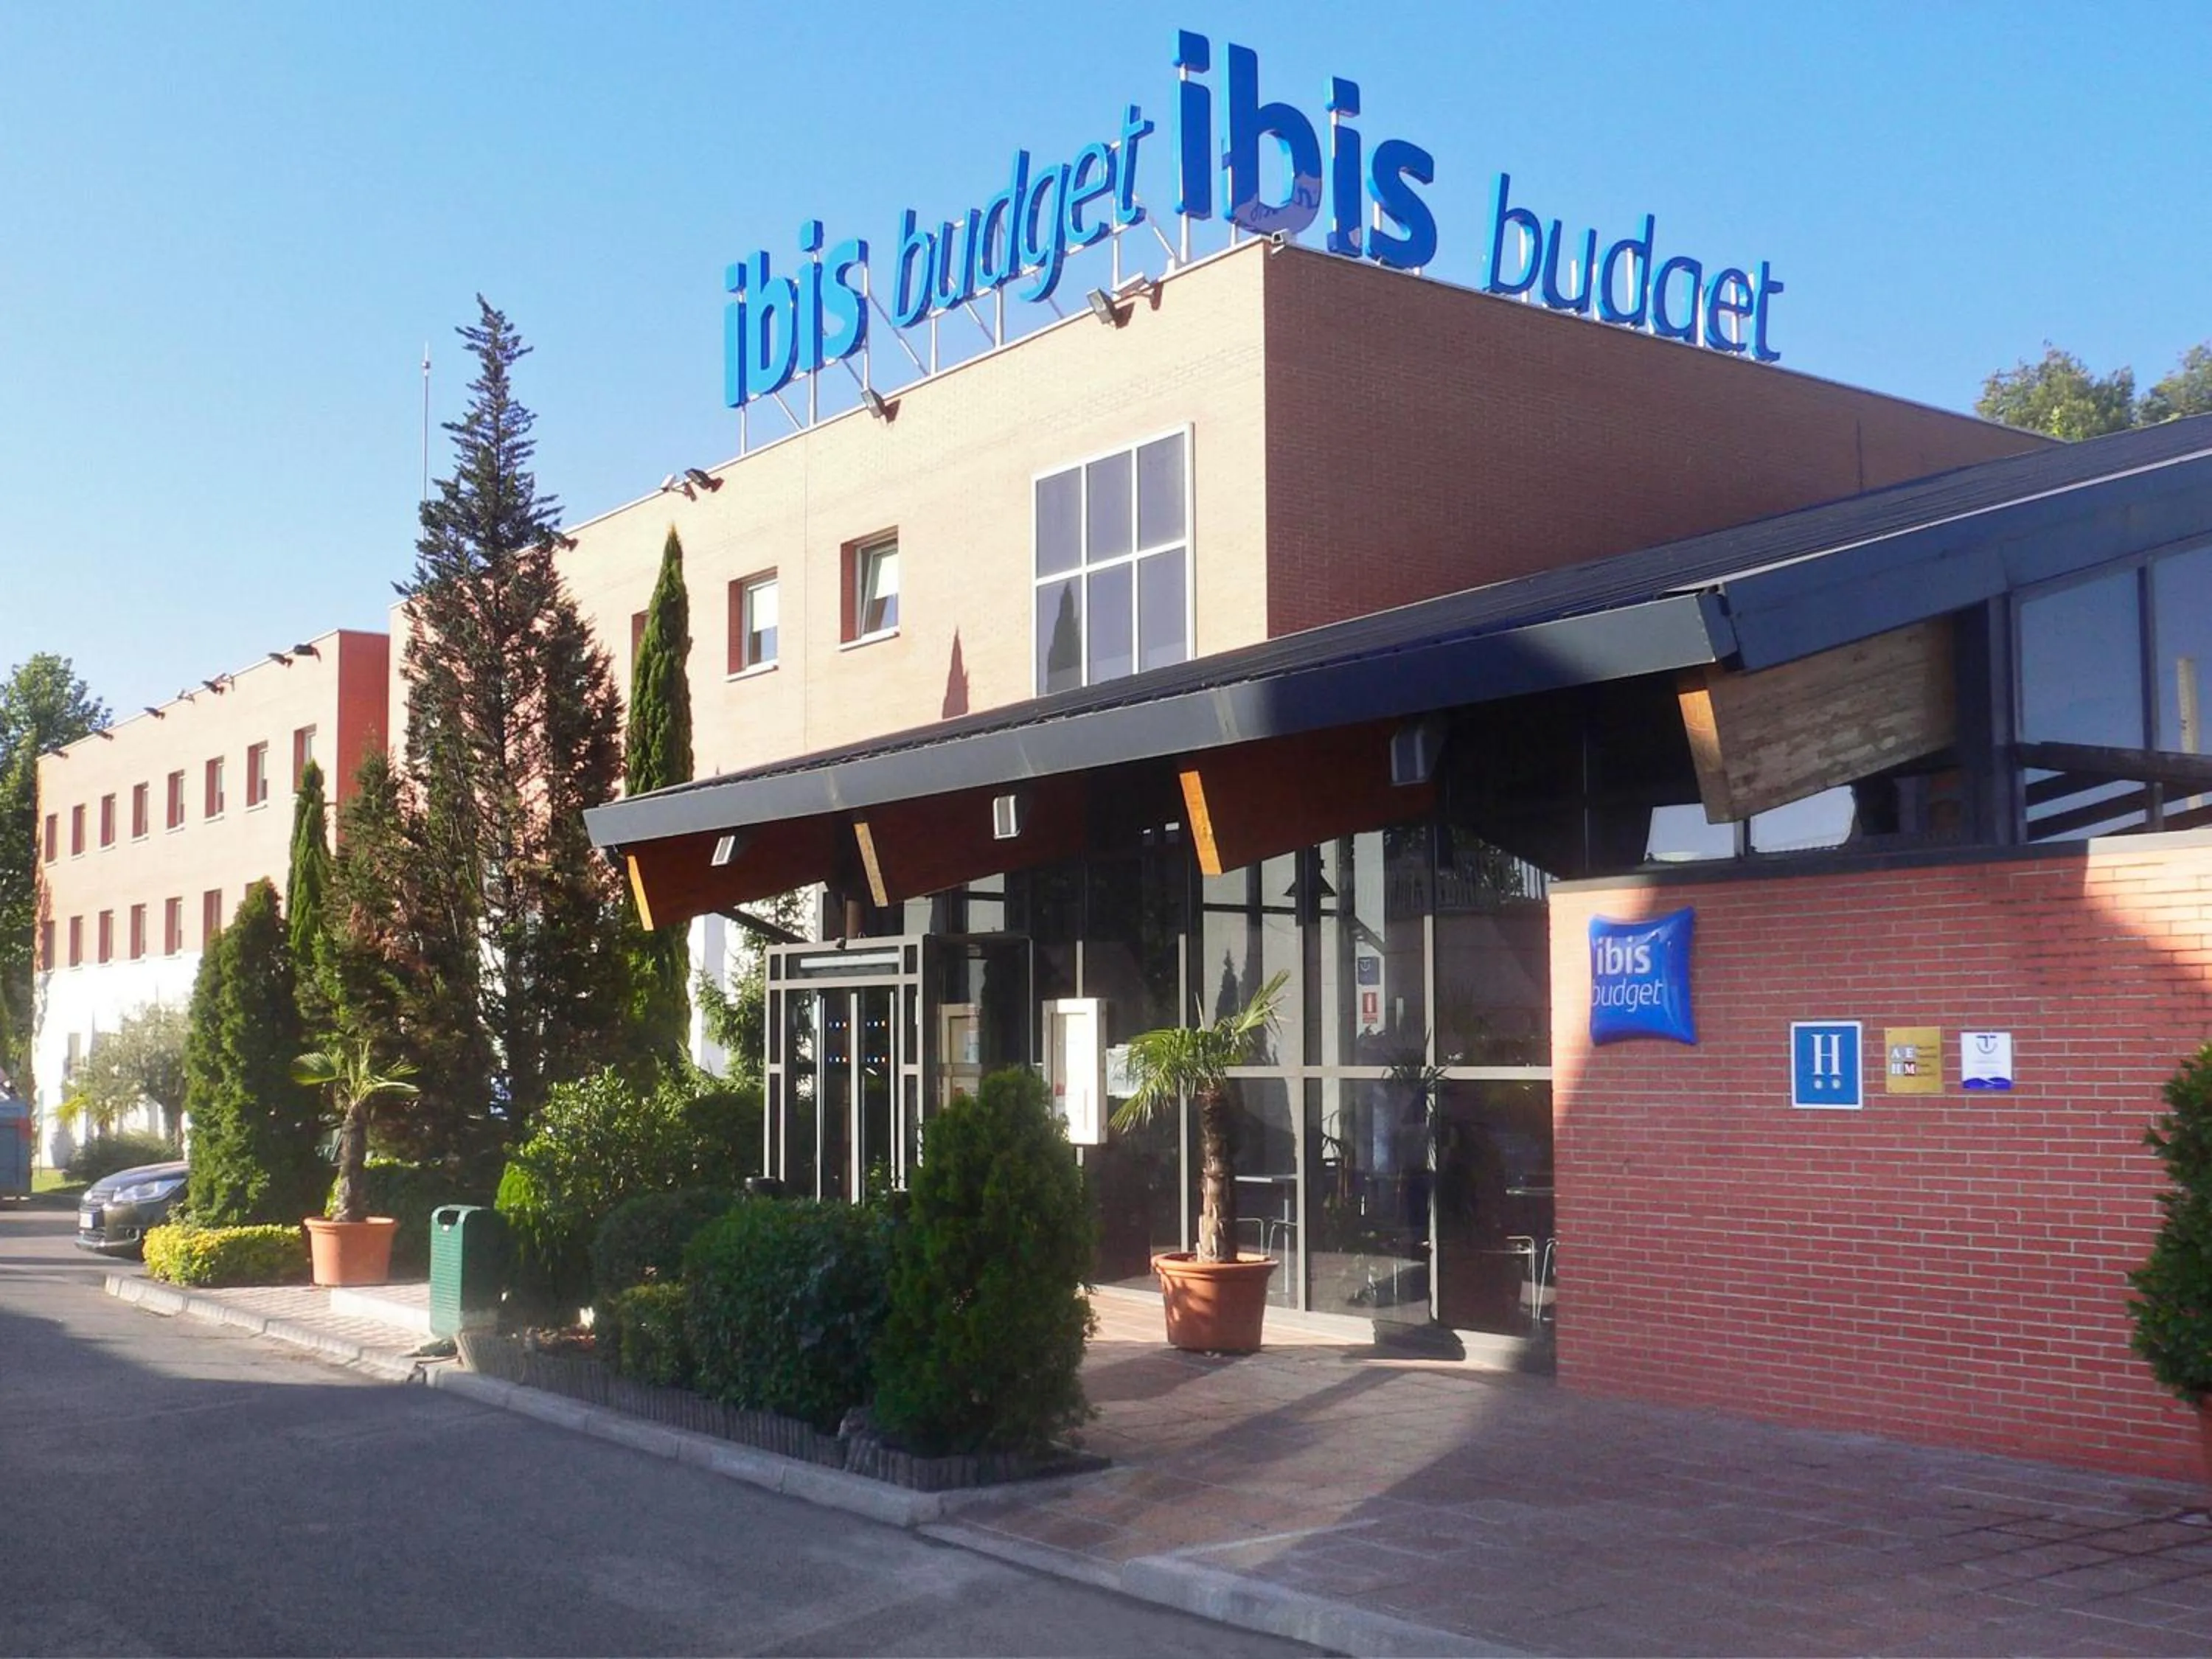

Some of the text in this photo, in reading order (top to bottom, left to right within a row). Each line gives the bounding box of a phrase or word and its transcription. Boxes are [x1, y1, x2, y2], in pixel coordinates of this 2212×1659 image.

[1172, 29, 1439, 270] ibis
[724, 104, 1155, 408] ibis budget
[1596, 936, 1652, 975] ibis
[1811, 1034, 1841, 1076] H
